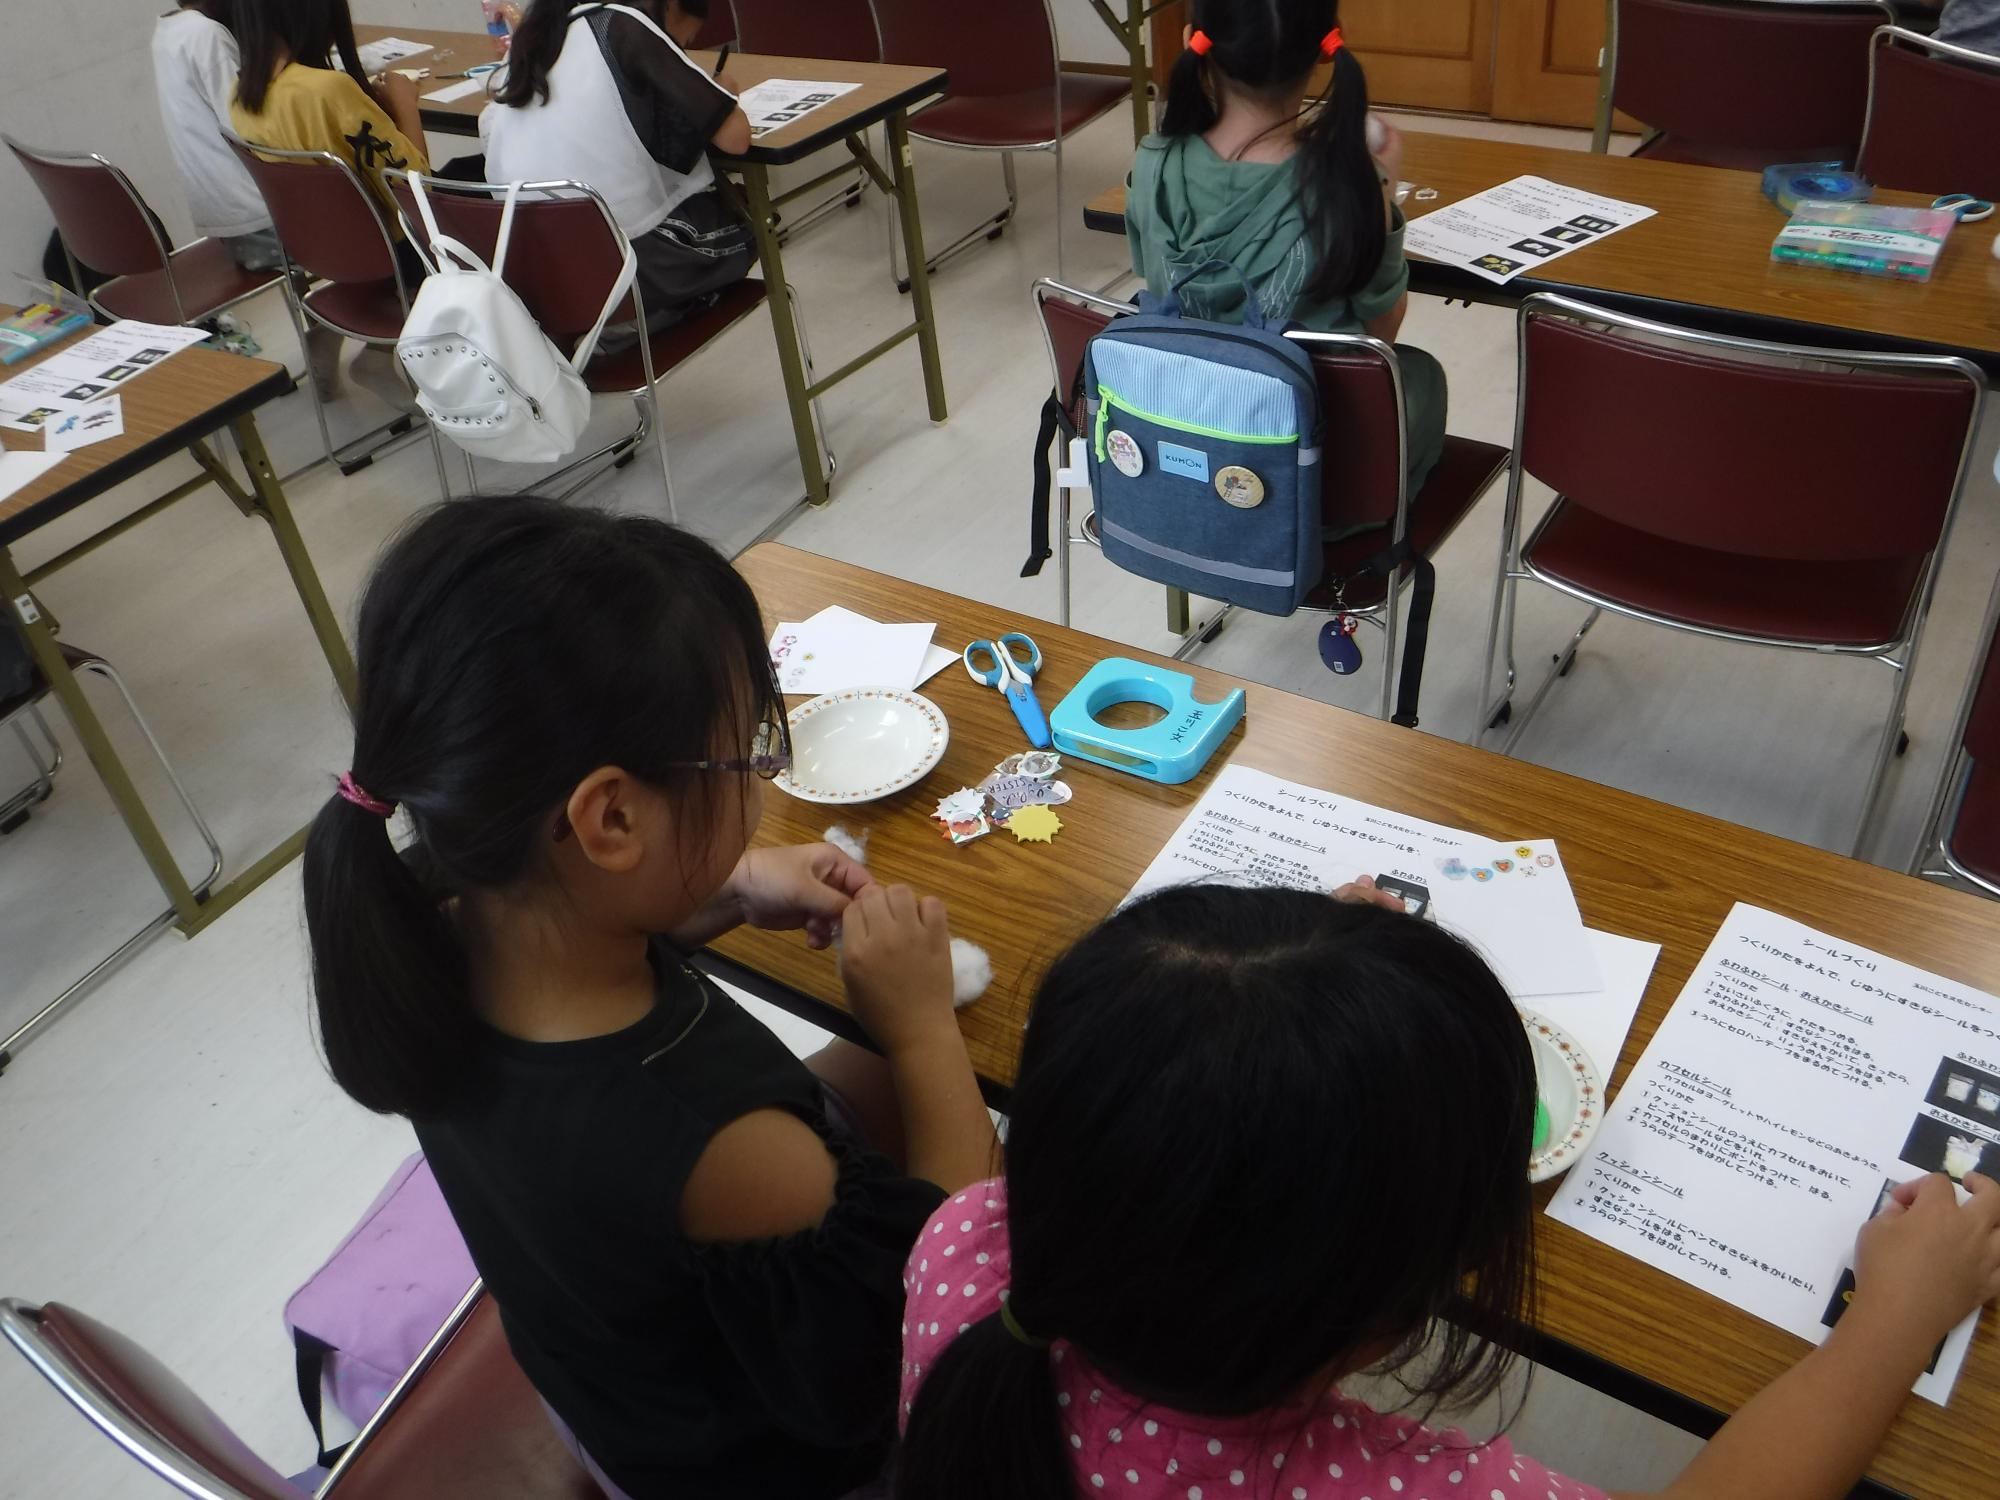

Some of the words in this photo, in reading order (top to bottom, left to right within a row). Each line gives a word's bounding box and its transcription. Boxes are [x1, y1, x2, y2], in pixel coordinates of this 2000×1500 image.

[1165, 455, 1202, 469] KUMON
[988, 778, 1026, 794] SISTER
[1277, 788, 1337, 812] シールづくり
[1199, 820, 1234, 836] つくりかた
[1224, 790, 1421, 855] つくりかたをよんで、じゆうにすきなシールを
[1802, 938, 1877, 972] シールづくり
[1714, 971, 1759, 993] つくりかた
[1956, 1051, 2000, 1075] ふわふわ
[1648, 1079, 1695, 1105] つくりかた
[1593, 1167, 1642, 1196] つくりかた
[1595, 1150, 1684, 1200] クッションシール
